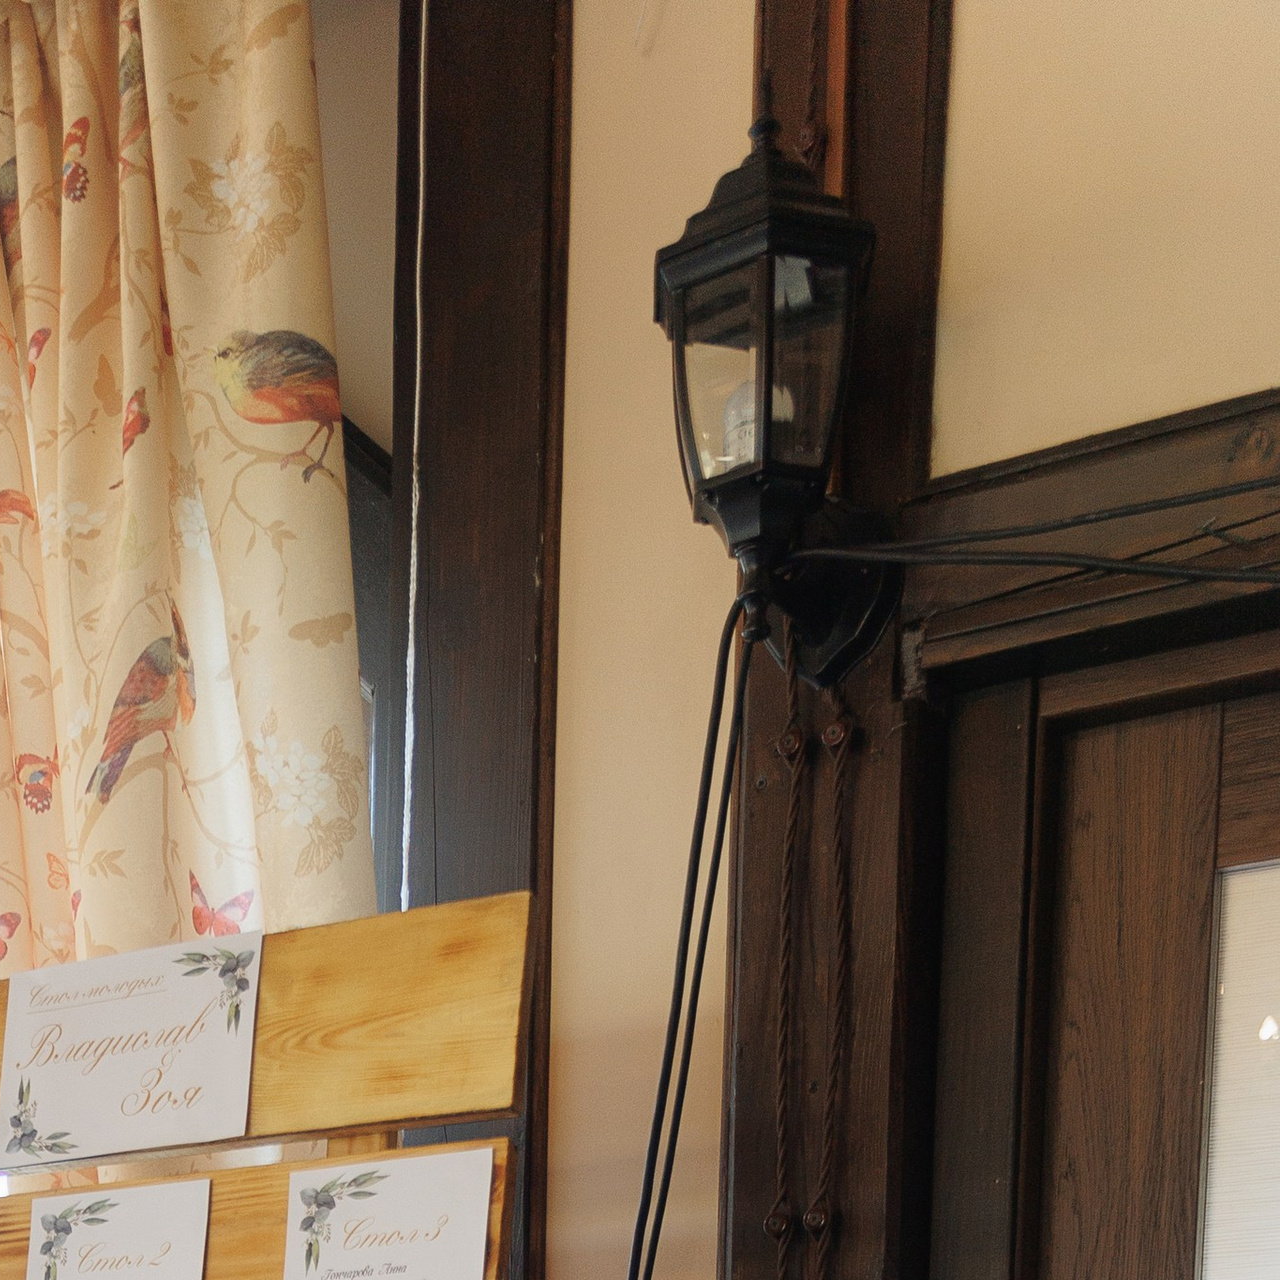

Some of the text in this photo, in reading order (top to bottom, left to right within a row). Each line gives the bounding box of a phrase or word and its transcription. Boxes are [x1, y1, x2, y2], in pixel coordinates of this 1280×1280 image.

[30, 974, 165, 1008] Стол молодых
[16, 998, 217, 1076] Владислав
[121, 1068, 204, 1117] Зоя
[342, 1215, 449, 1251] Стол 3
[77, 1241, 172, 1274] Стол 2
[321, 1263, 407, 1280] Гончарова Анна
